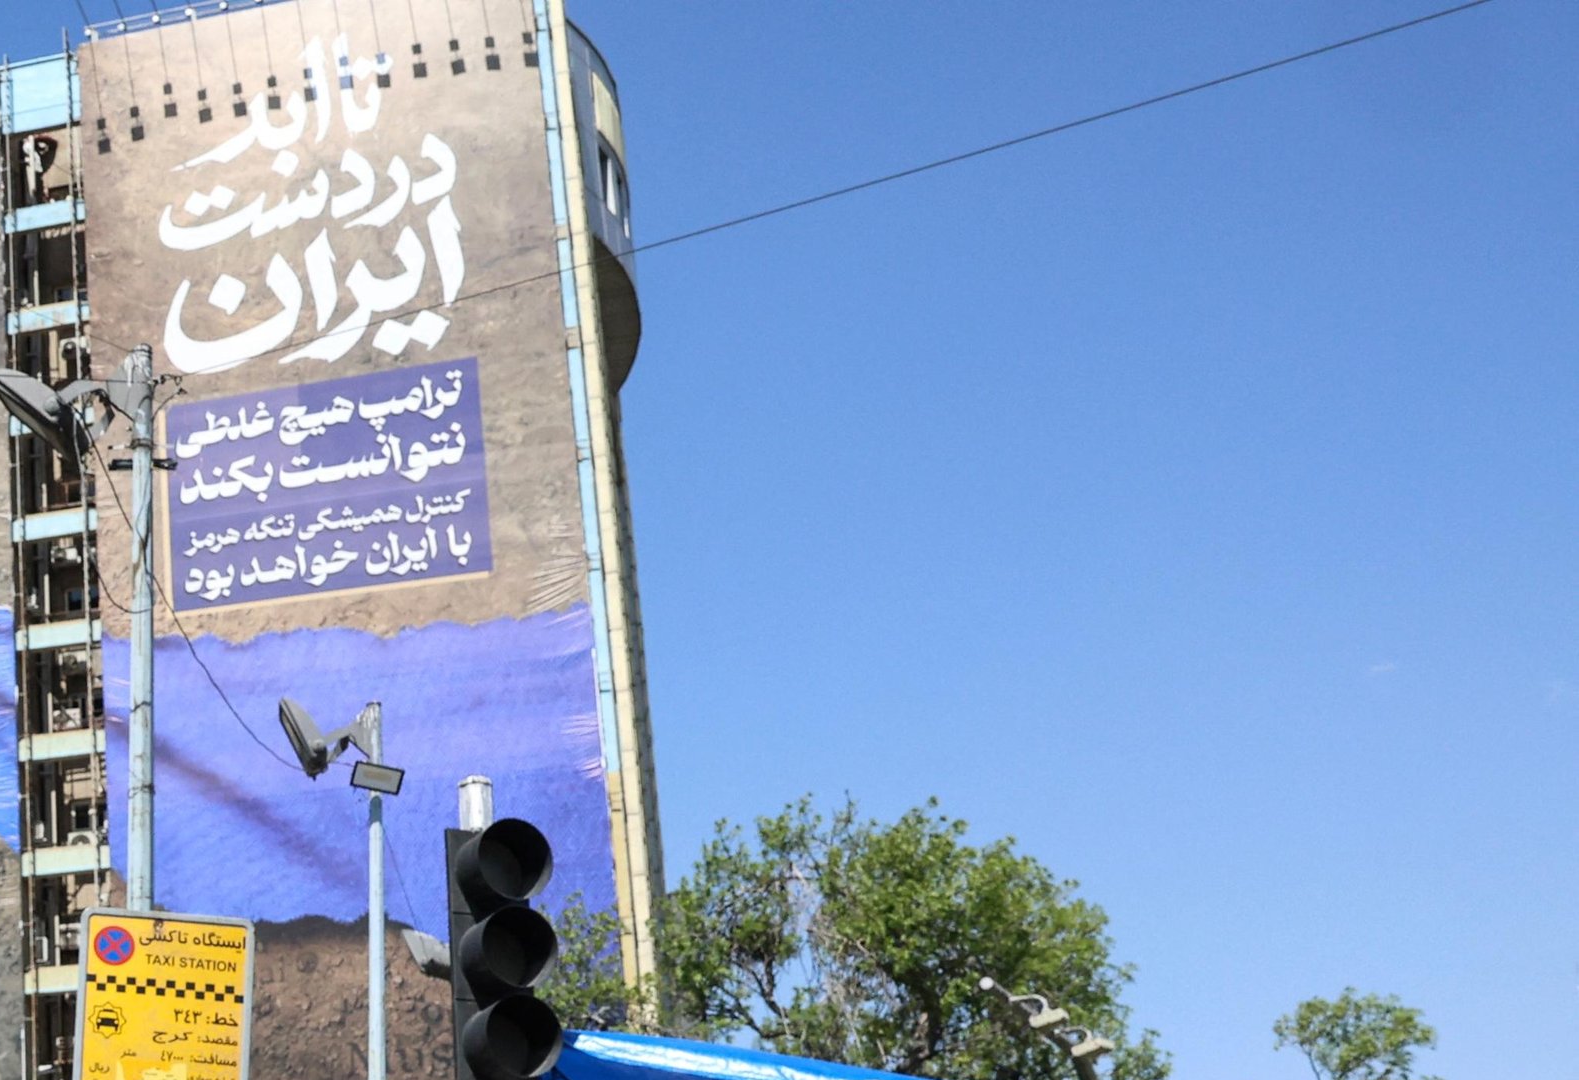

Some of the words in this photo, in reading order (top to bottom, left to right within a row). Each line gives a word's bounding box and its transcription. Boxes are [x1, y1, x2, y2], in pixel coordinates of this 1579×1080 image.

[170, 36, 332, 176] ابد
[158, 148, 376, 251] دست
[162, 195, 465, 375] ایران
[278, 395, 355, 446] هیچ
[358, 368, 463, 431] ترامپ
[175, 401, 275, 458] غلطی
[278, 421, 467, 489] نتوانست
[180, 454, 274, 504] بکند
[243, 513, 296, 542] تنگه
[405, 488, 472, 524] کنترل
[183, 527, 241, 556] هرمز
[240, 539, 359, 587] خواهد
[365, 525, 438, 576] ایران
[446, 524, 472, 566] با
[184, 563, 236, 601] بود
[139, 929, 188, 946] تاکسی
[193, 931, 246, 954] ایستگاه
[145, 953, 175, 967] TAXI
[179, 956, 237, 972] STATION
[152, 1030, 192, 1044] کرج
[89, 1062, 110, 1073] ریال
